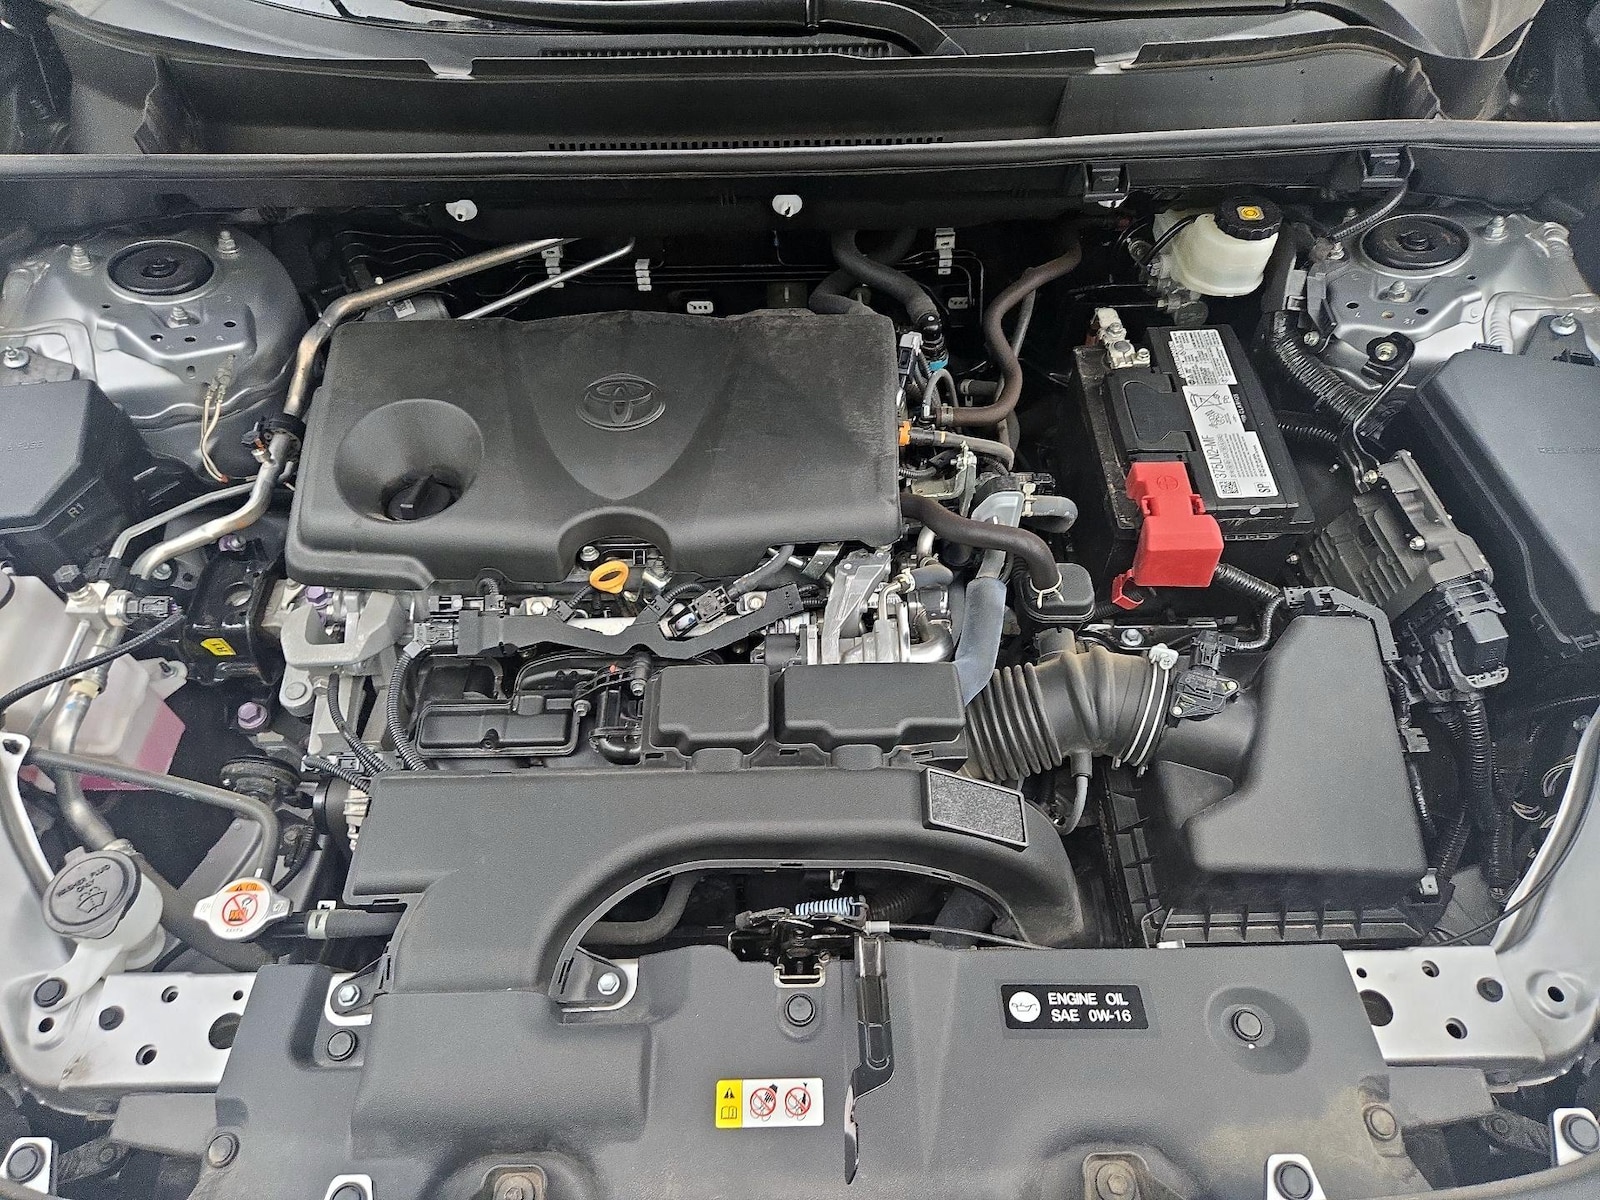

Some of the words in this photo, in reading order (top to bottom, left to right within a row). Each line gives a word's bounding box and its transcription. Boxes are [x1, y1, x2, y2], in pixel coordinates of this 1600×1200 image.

[1201, 434, 1227, 479] 375LN2-MF
[1257, 483, 1271, 493] SP
[1048, 992, 1098, 1005] ENGINE
[1105, 992, 1129, 1005] OIL
[1051, 1009, 1080, 1022] SAE
[1088, 1009, 1132, 1022] 0W-16
